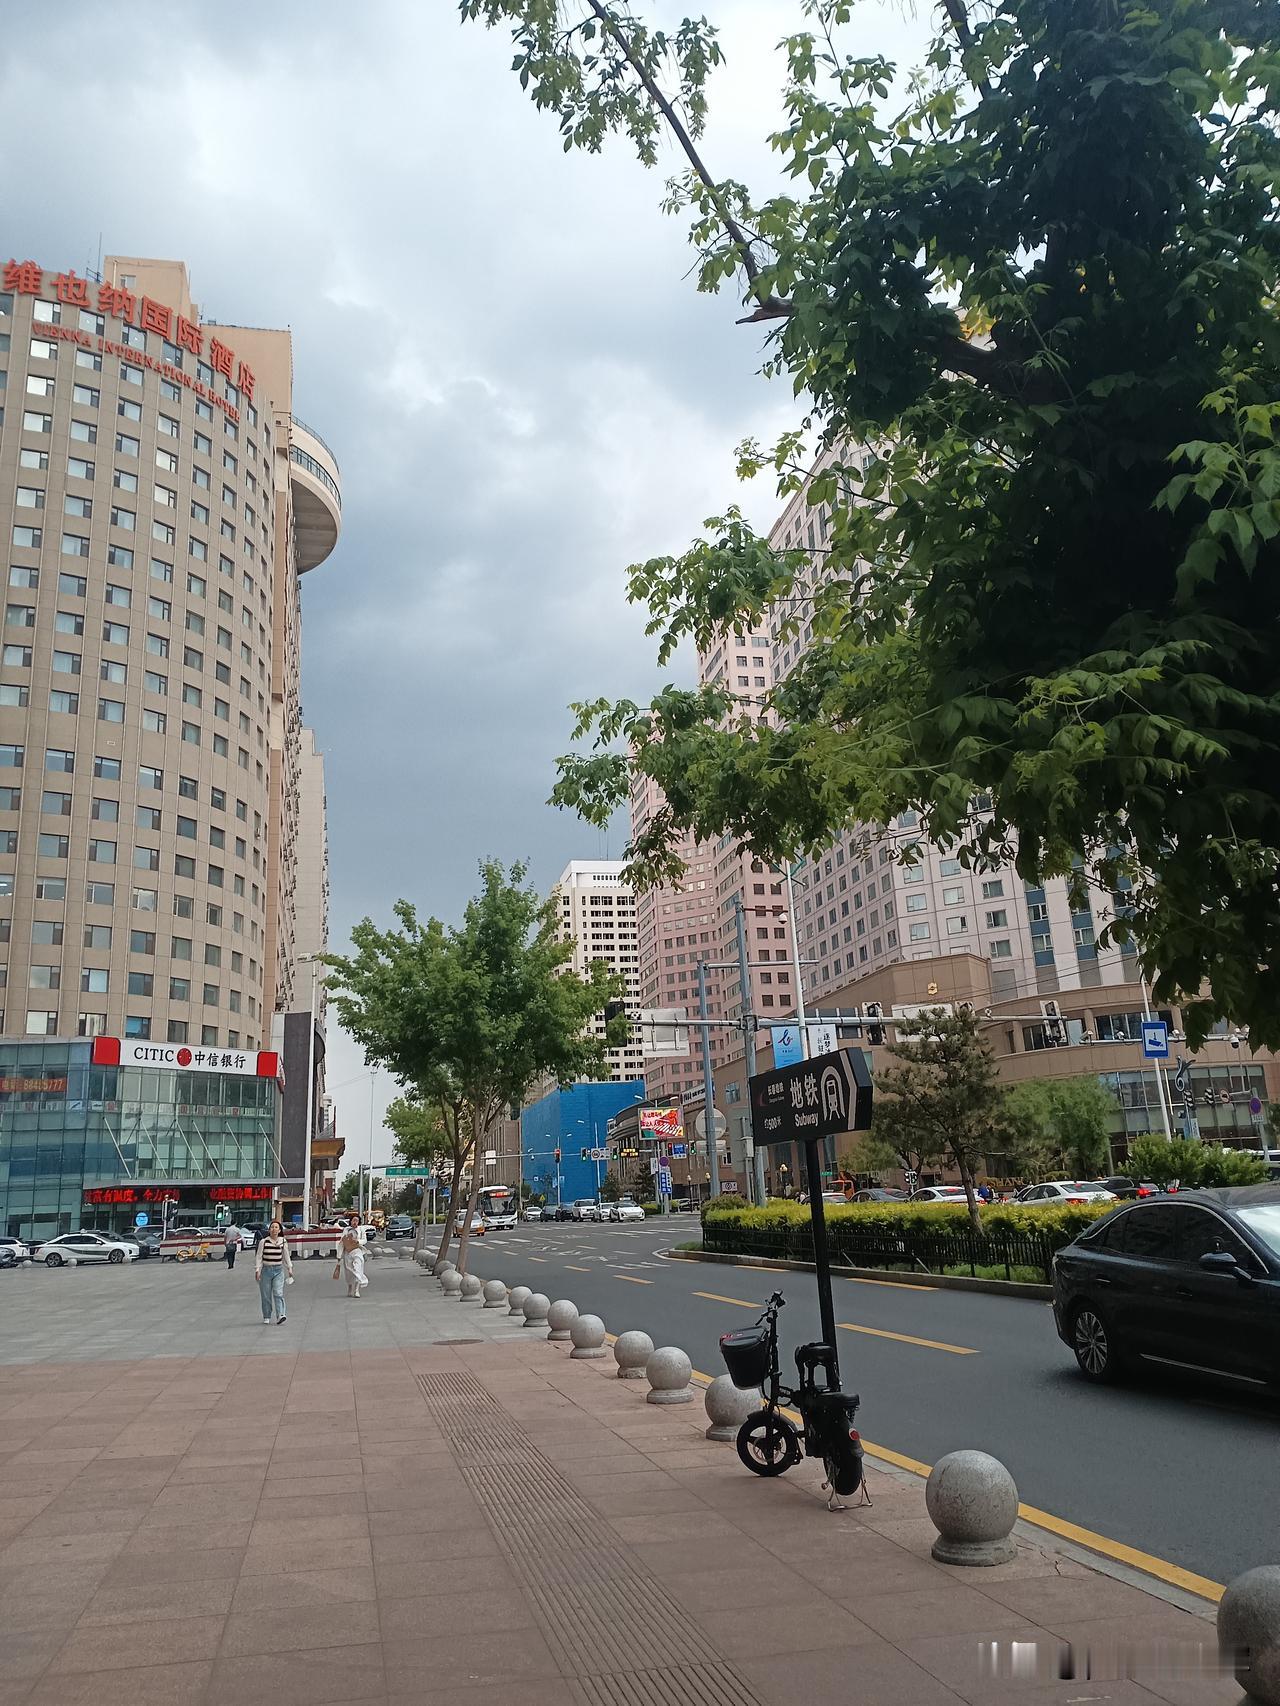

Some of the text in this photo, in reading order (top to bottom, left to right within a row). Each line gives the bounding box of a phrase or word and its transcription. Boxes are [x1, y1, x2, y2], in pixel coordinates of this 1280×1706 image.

[3, 258, 256, 402] 维也纳国际酒店
[32, 322, 240, 423] VIENNA INTERNATIONAL HOTEL
[134, 1046, 175, 1062] CITIC
[194, 1050, 247, 1069] 中信银行
[767, 1081, 785, 1096] 长春地铁
[789, 1072, 819, 1109] 地铁
[764, 1115, 782, 1130] 约500米
[794, 1111, 819, 1127] Subway
